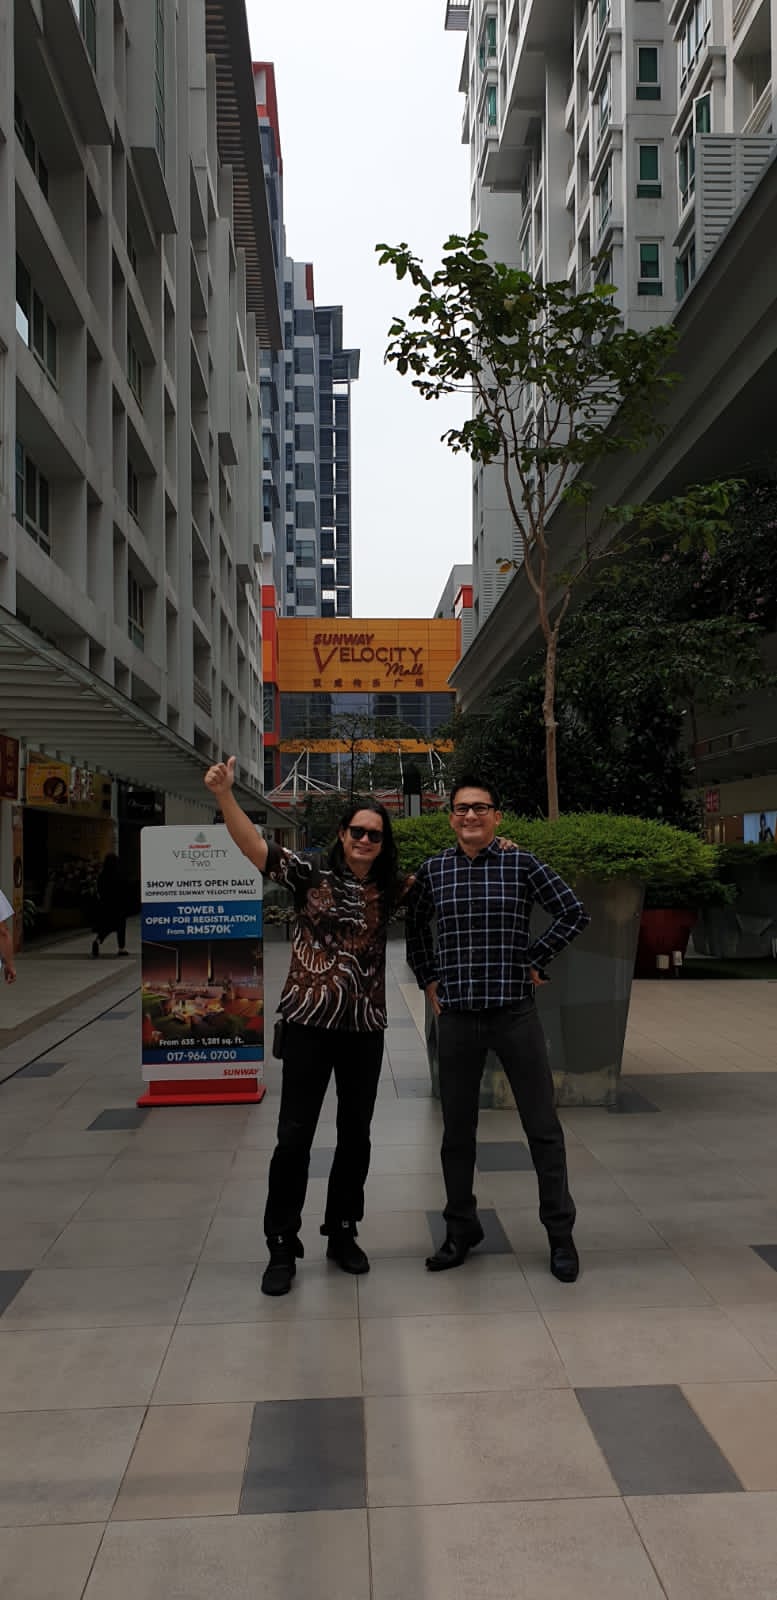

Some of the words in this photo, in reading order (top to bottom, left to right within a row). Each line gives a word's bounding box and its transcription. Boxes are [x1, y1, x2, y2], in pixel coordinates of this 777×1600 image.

[313, 633, 375, 646] SUNWAY
[313, 647, 424, 674] VELOCITY
[384, 662, 424, 677] Mall
[172, 849, 229, 860] VELOCITY
[177, 880, 202, 888] UNITS
[231, 879, 255, 887] DAILY
[177, 905, 215, 915] TOWER
[217, 905, 225, 914] B
[145, 916, 171, 925] OPEN
[172, 916, 191, 924] FOR
[192, 914, 257, 923] REGISTRATION
[159, 1039, 179, 1047] From
[181, 1038, 195, 1046] 635
[221, 1038, 233, 1046] sq.
[166, 1051, 208, 1062] 017-964
[209, 1050, 237, 1061] 0700
